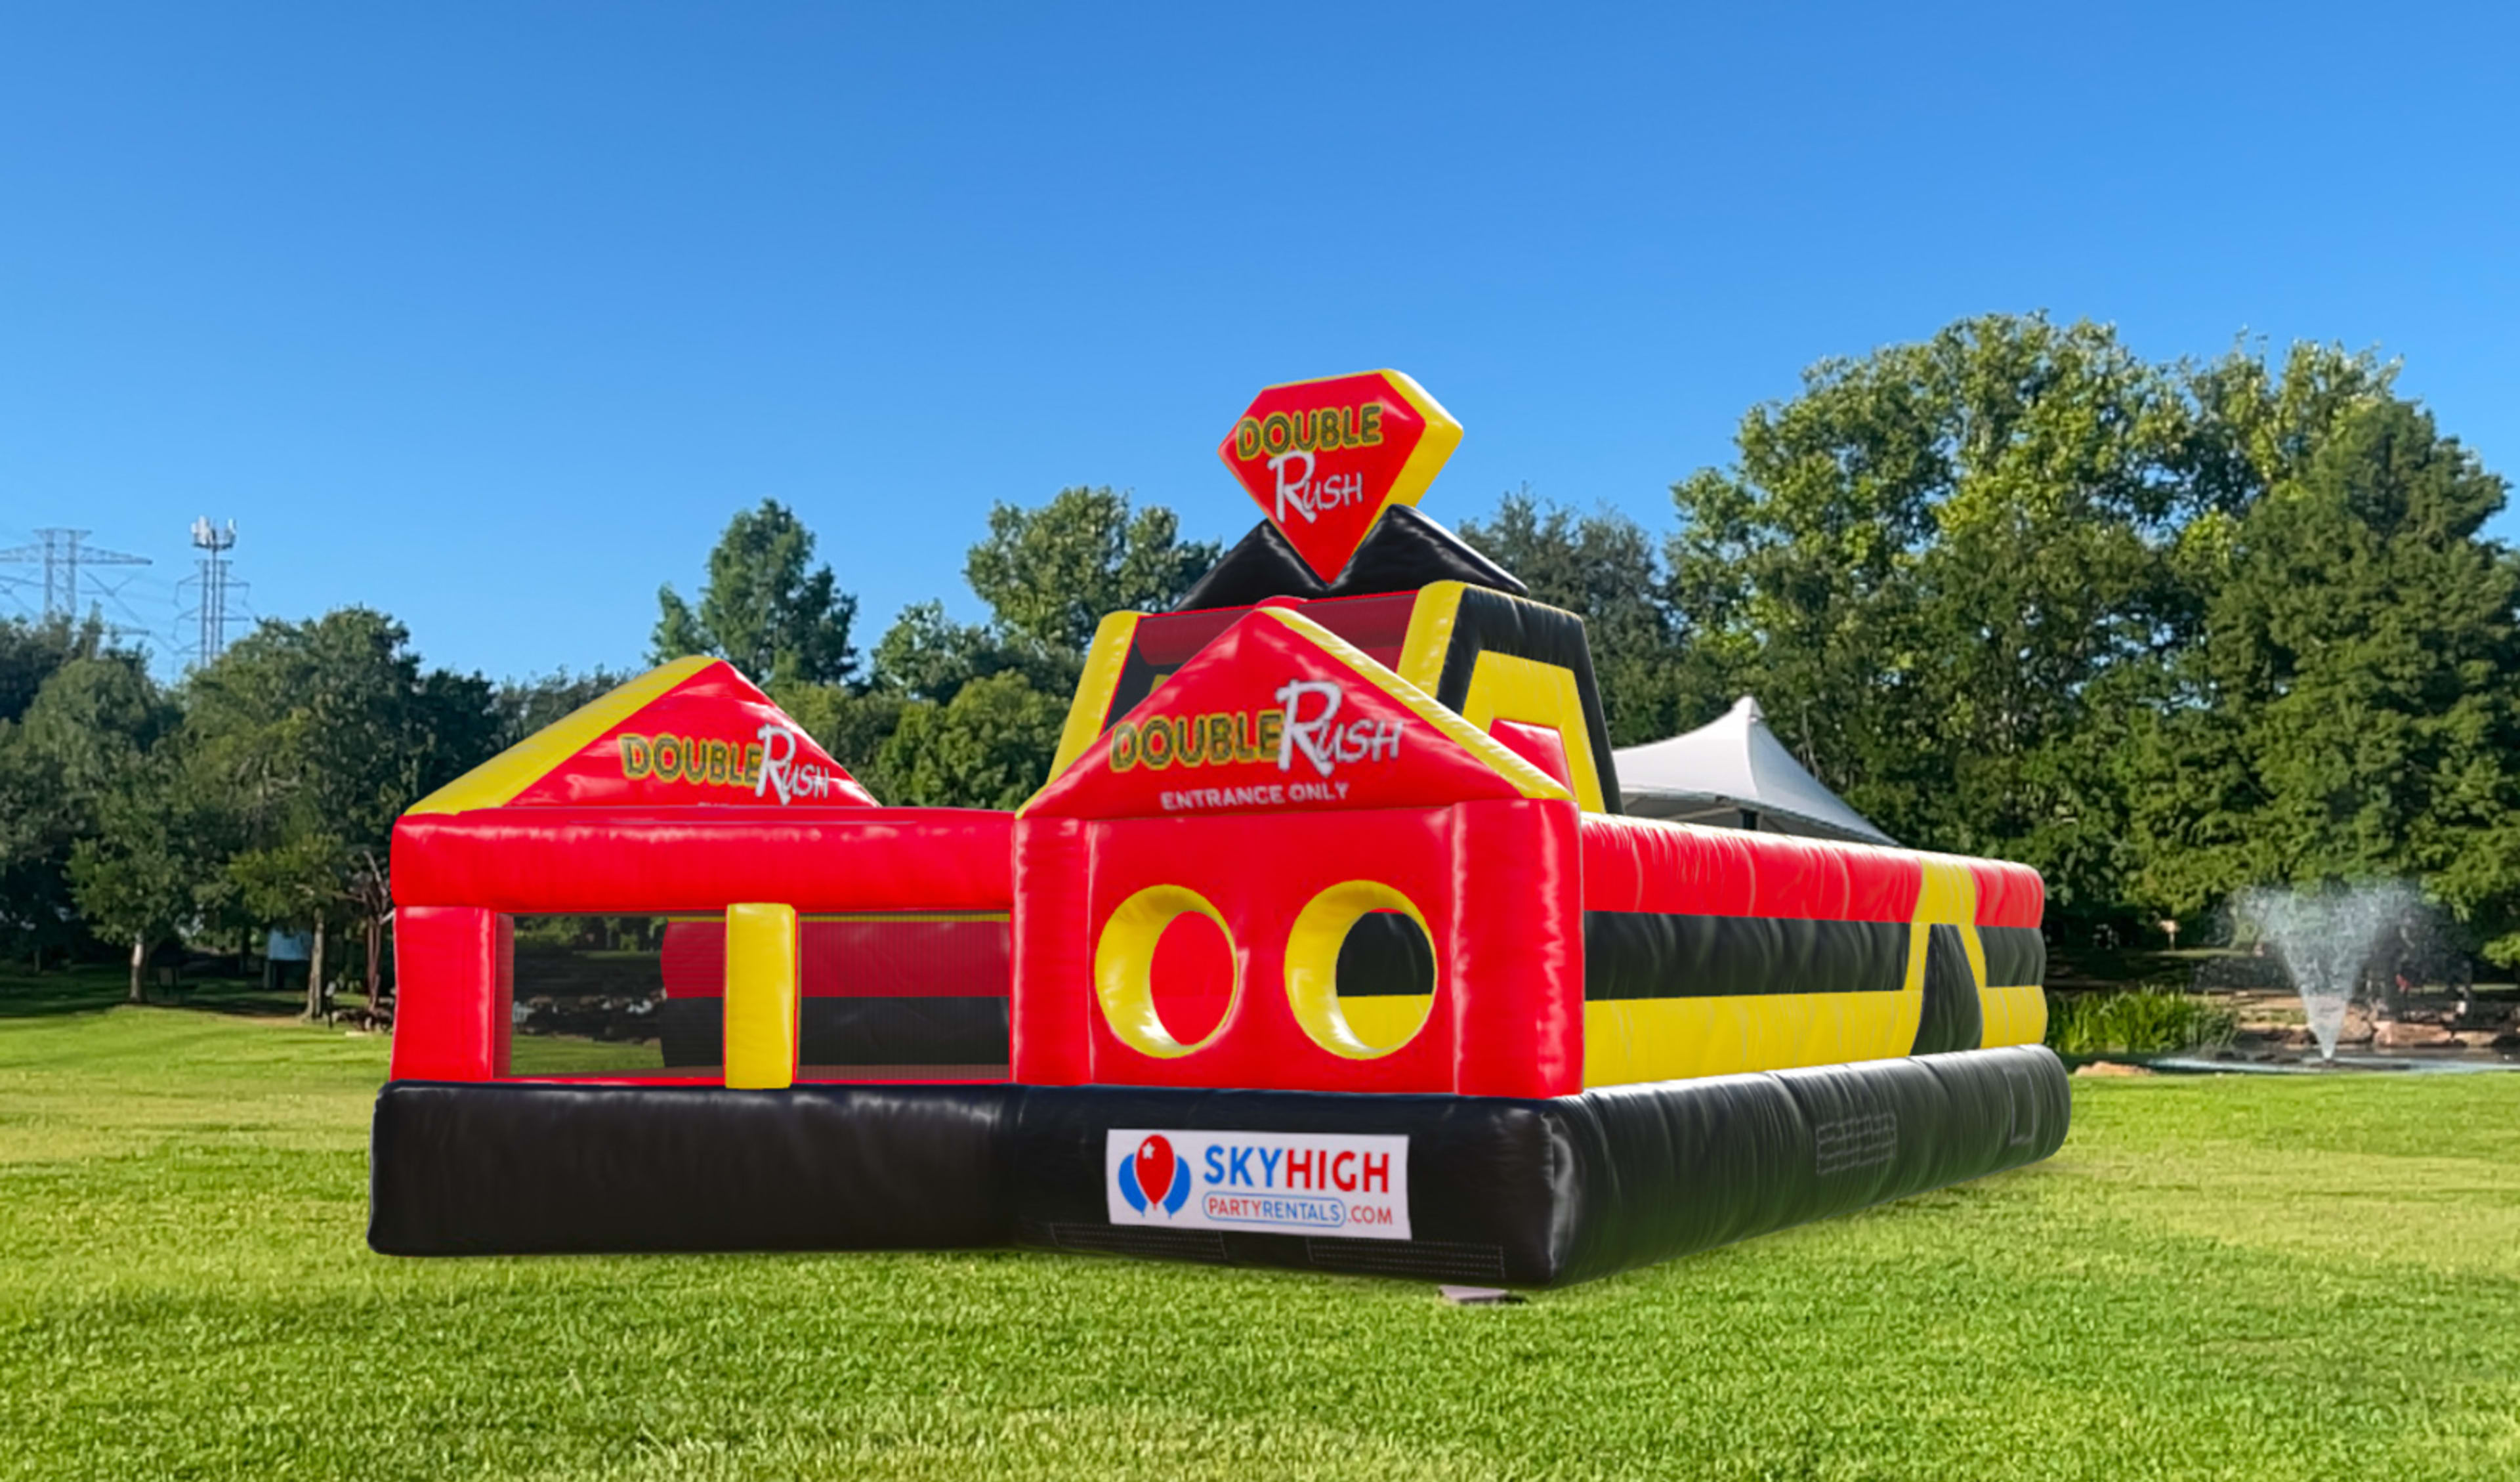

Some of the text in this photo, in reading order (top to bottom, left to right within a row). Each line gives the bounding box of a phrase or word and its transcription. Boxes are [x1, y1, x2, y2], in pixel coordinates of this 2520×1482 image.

[1236, 402, 1384, 461] DOUBLE
[617, 732, 763, 788] DOUBLE
[1110, 709, 1284, 773] DOUBLE
[1160, 782, 1349, 811] ENTRANCE ONLY
[1203, 1144, 1390, 1193] SKYHIGH
